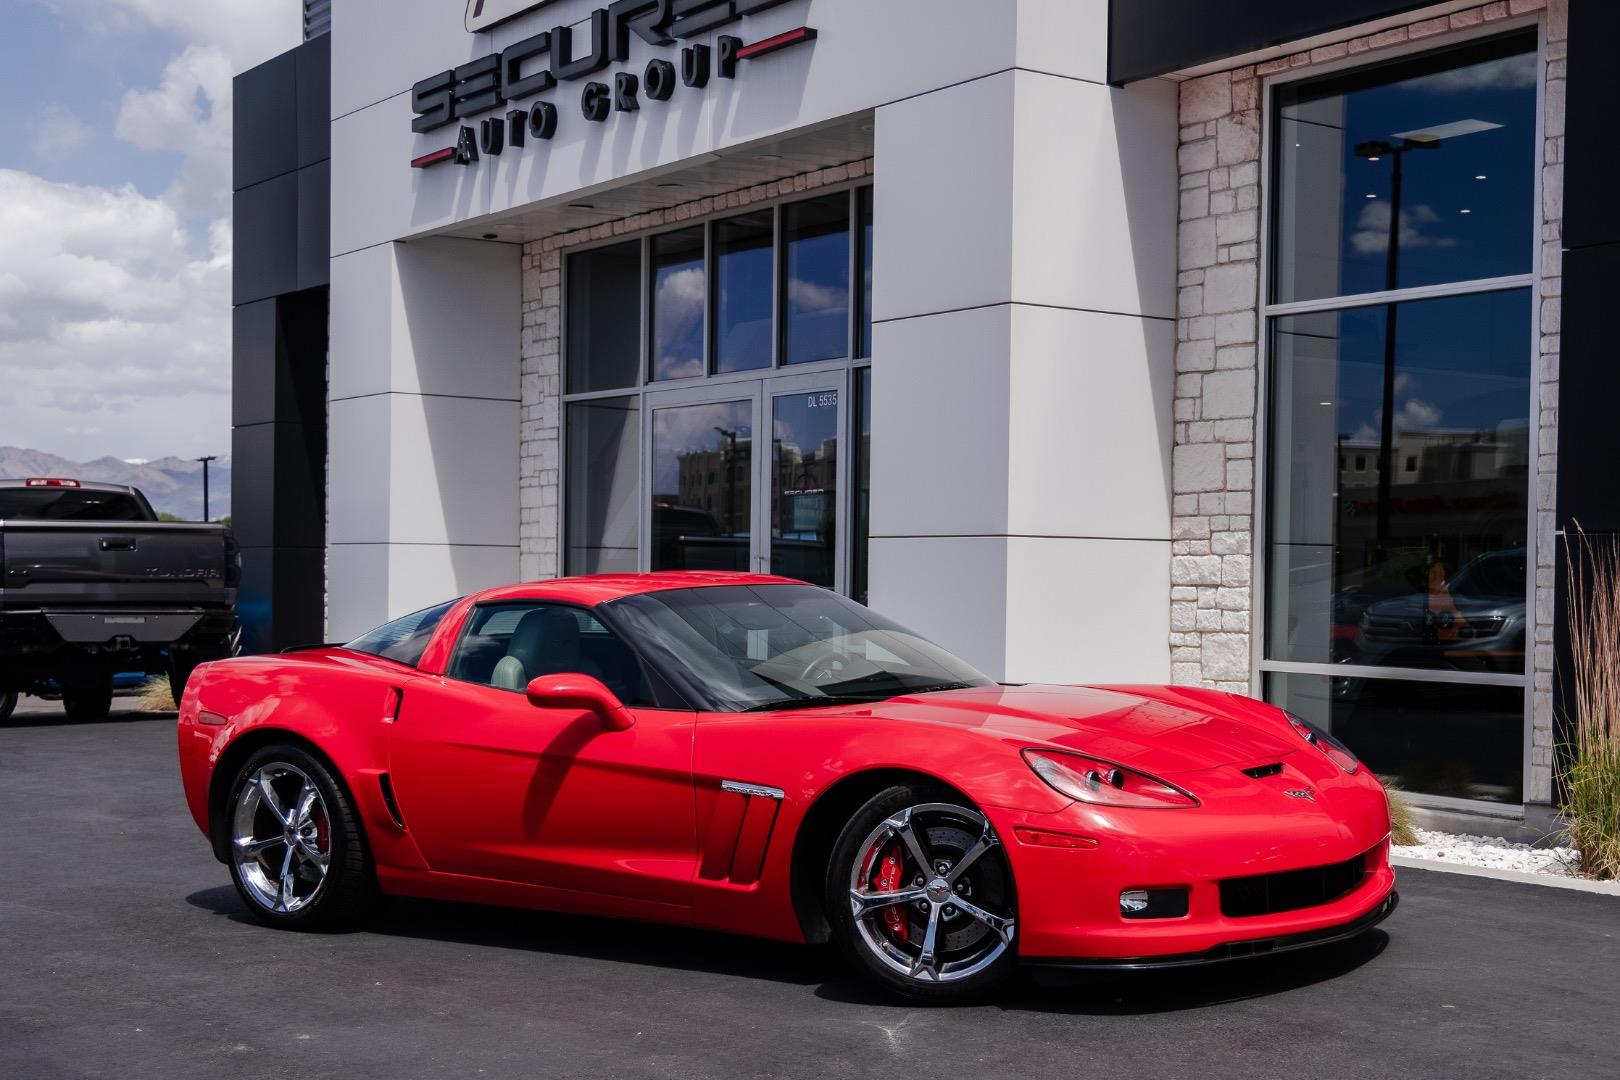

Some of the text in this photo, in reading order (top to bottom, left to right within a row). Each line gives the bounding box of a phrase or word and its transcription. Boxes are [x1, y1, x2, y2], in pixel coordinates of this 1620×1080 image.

[411, 0, 796, 133] SECURE
[454, 35, 743, 165] AUTO GROUP
[808, 394, 837, 407] DL 5535
